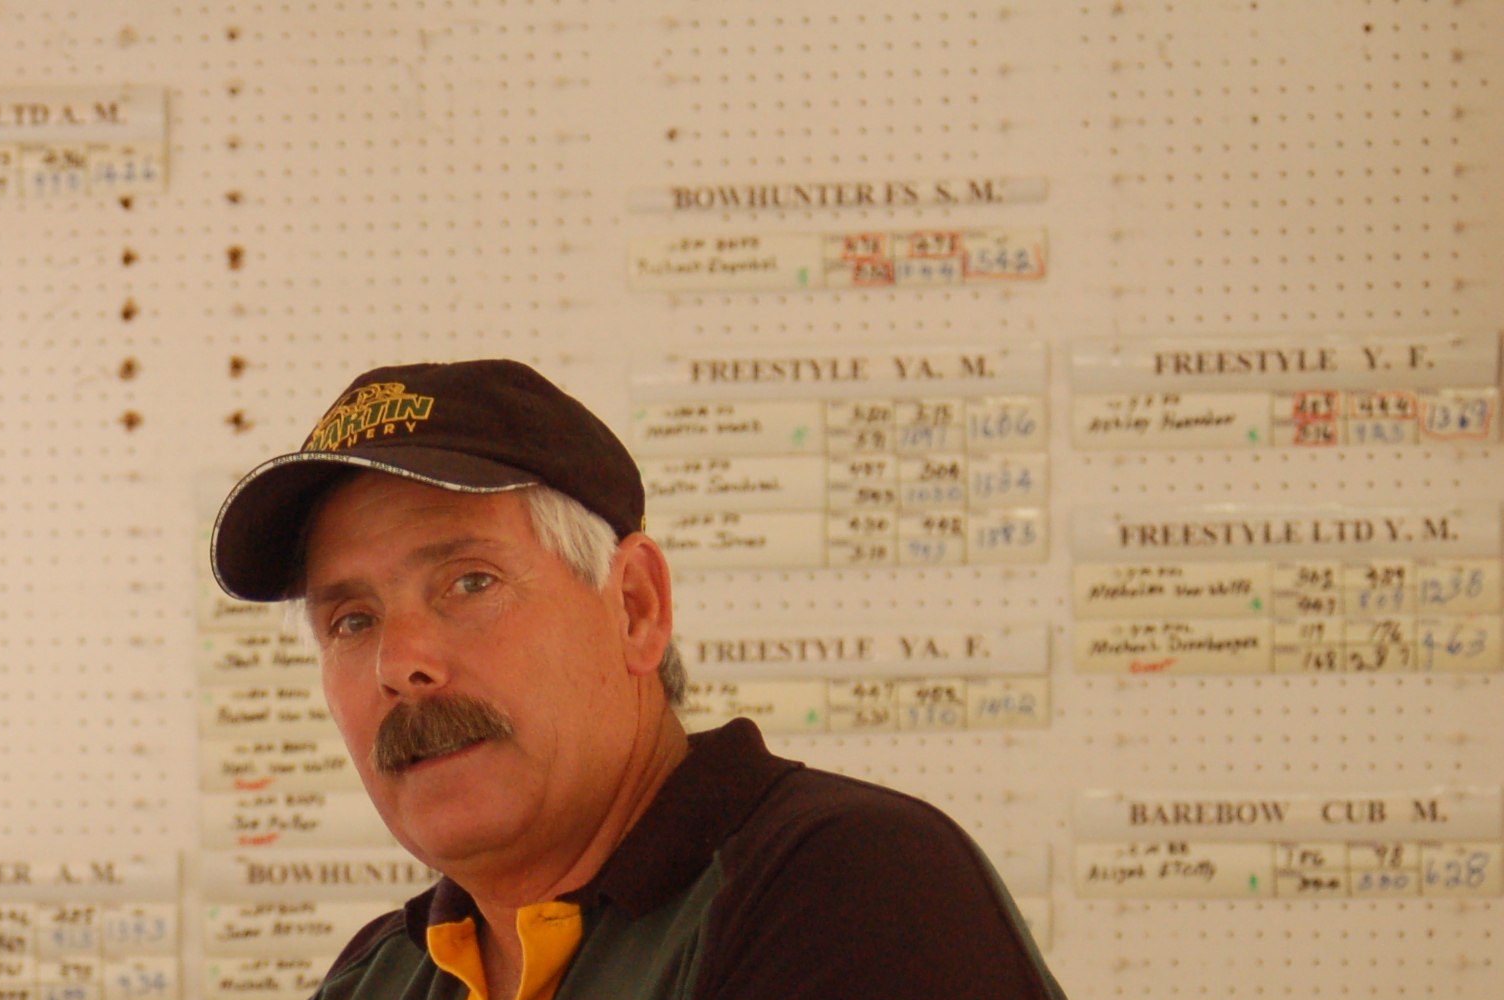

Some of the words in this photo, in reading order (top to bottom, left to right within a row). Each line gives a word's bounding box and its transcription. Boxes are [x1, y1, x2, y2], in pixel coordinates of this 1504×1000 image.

[670, 184, 876, 210] BOWHUNTER
[968, 178, 1004, 202] M.
[690, 357, 870, 384] FREESTYLE
[894, 356, 943, 381] YA.
[960, 354, 996, 380] M.
[1154, 348, 1338, 376] FREESTYLE
[1363, 347, 1393, 370] Y.
[1409, 345, 1436, 369] F.
[1119, 521, 1304, 549] FREESTYLE
[1311, 519, 1374, 544] LTD
[1384, 518, 1413, 543] Y.
[1424, 518, 1460, 541] M.
[698, 636, 874, 666] FREESTYLE
[899, 635, 950, 659] YA.
[966, 634, 991, 659] F.
[1130, 801, 1291, 826] BAREBOW
[1321, 800, 1387, 825] CUB
[1410, 800, 1449, 823] M.
[53, 863, 82, 886] A.
[90, 862, 125, 885] M.
